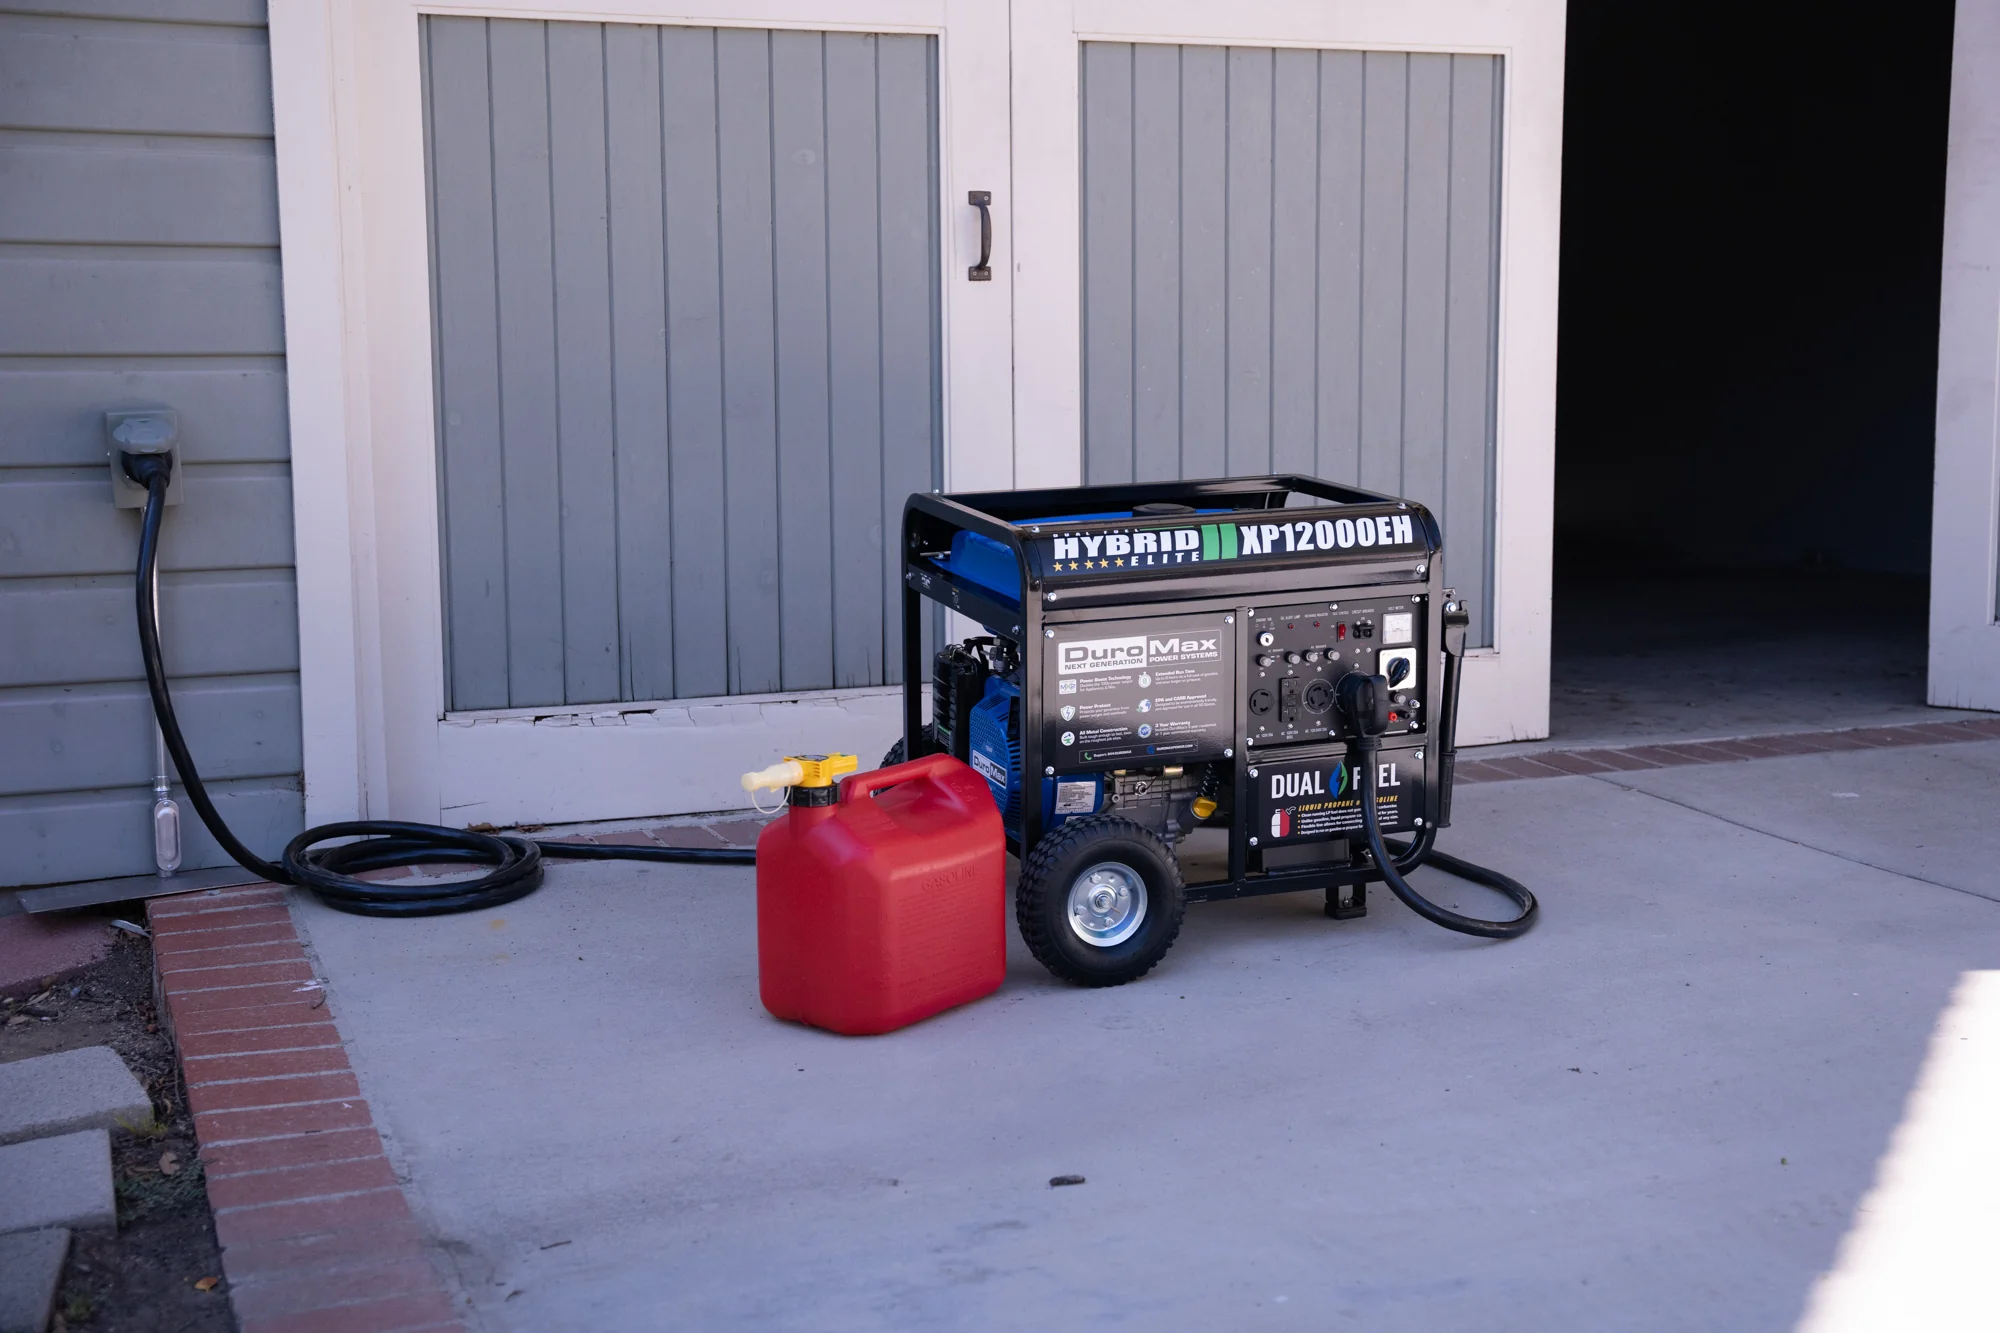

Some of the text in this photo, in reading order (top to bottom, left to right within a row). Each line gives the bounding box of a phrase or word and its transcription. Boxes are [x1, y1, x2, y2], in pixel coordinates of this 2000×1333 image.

[1239, 515, 1413, 555] XP12000EH
[1054, 529, 1200, 560] HYBRID
[1130, 551, 1200, 567] ELITE
[1064, 658, 1143, 670] NEXT GENERATION
[1149, 651, 1218, 663] POWER SYSTEMS
[1271, 763, 1400, 799] DUAL FEL
[1298, 803, 1321, 812] LIQUID
[1324, 799, 1354, 809] PROPANE
